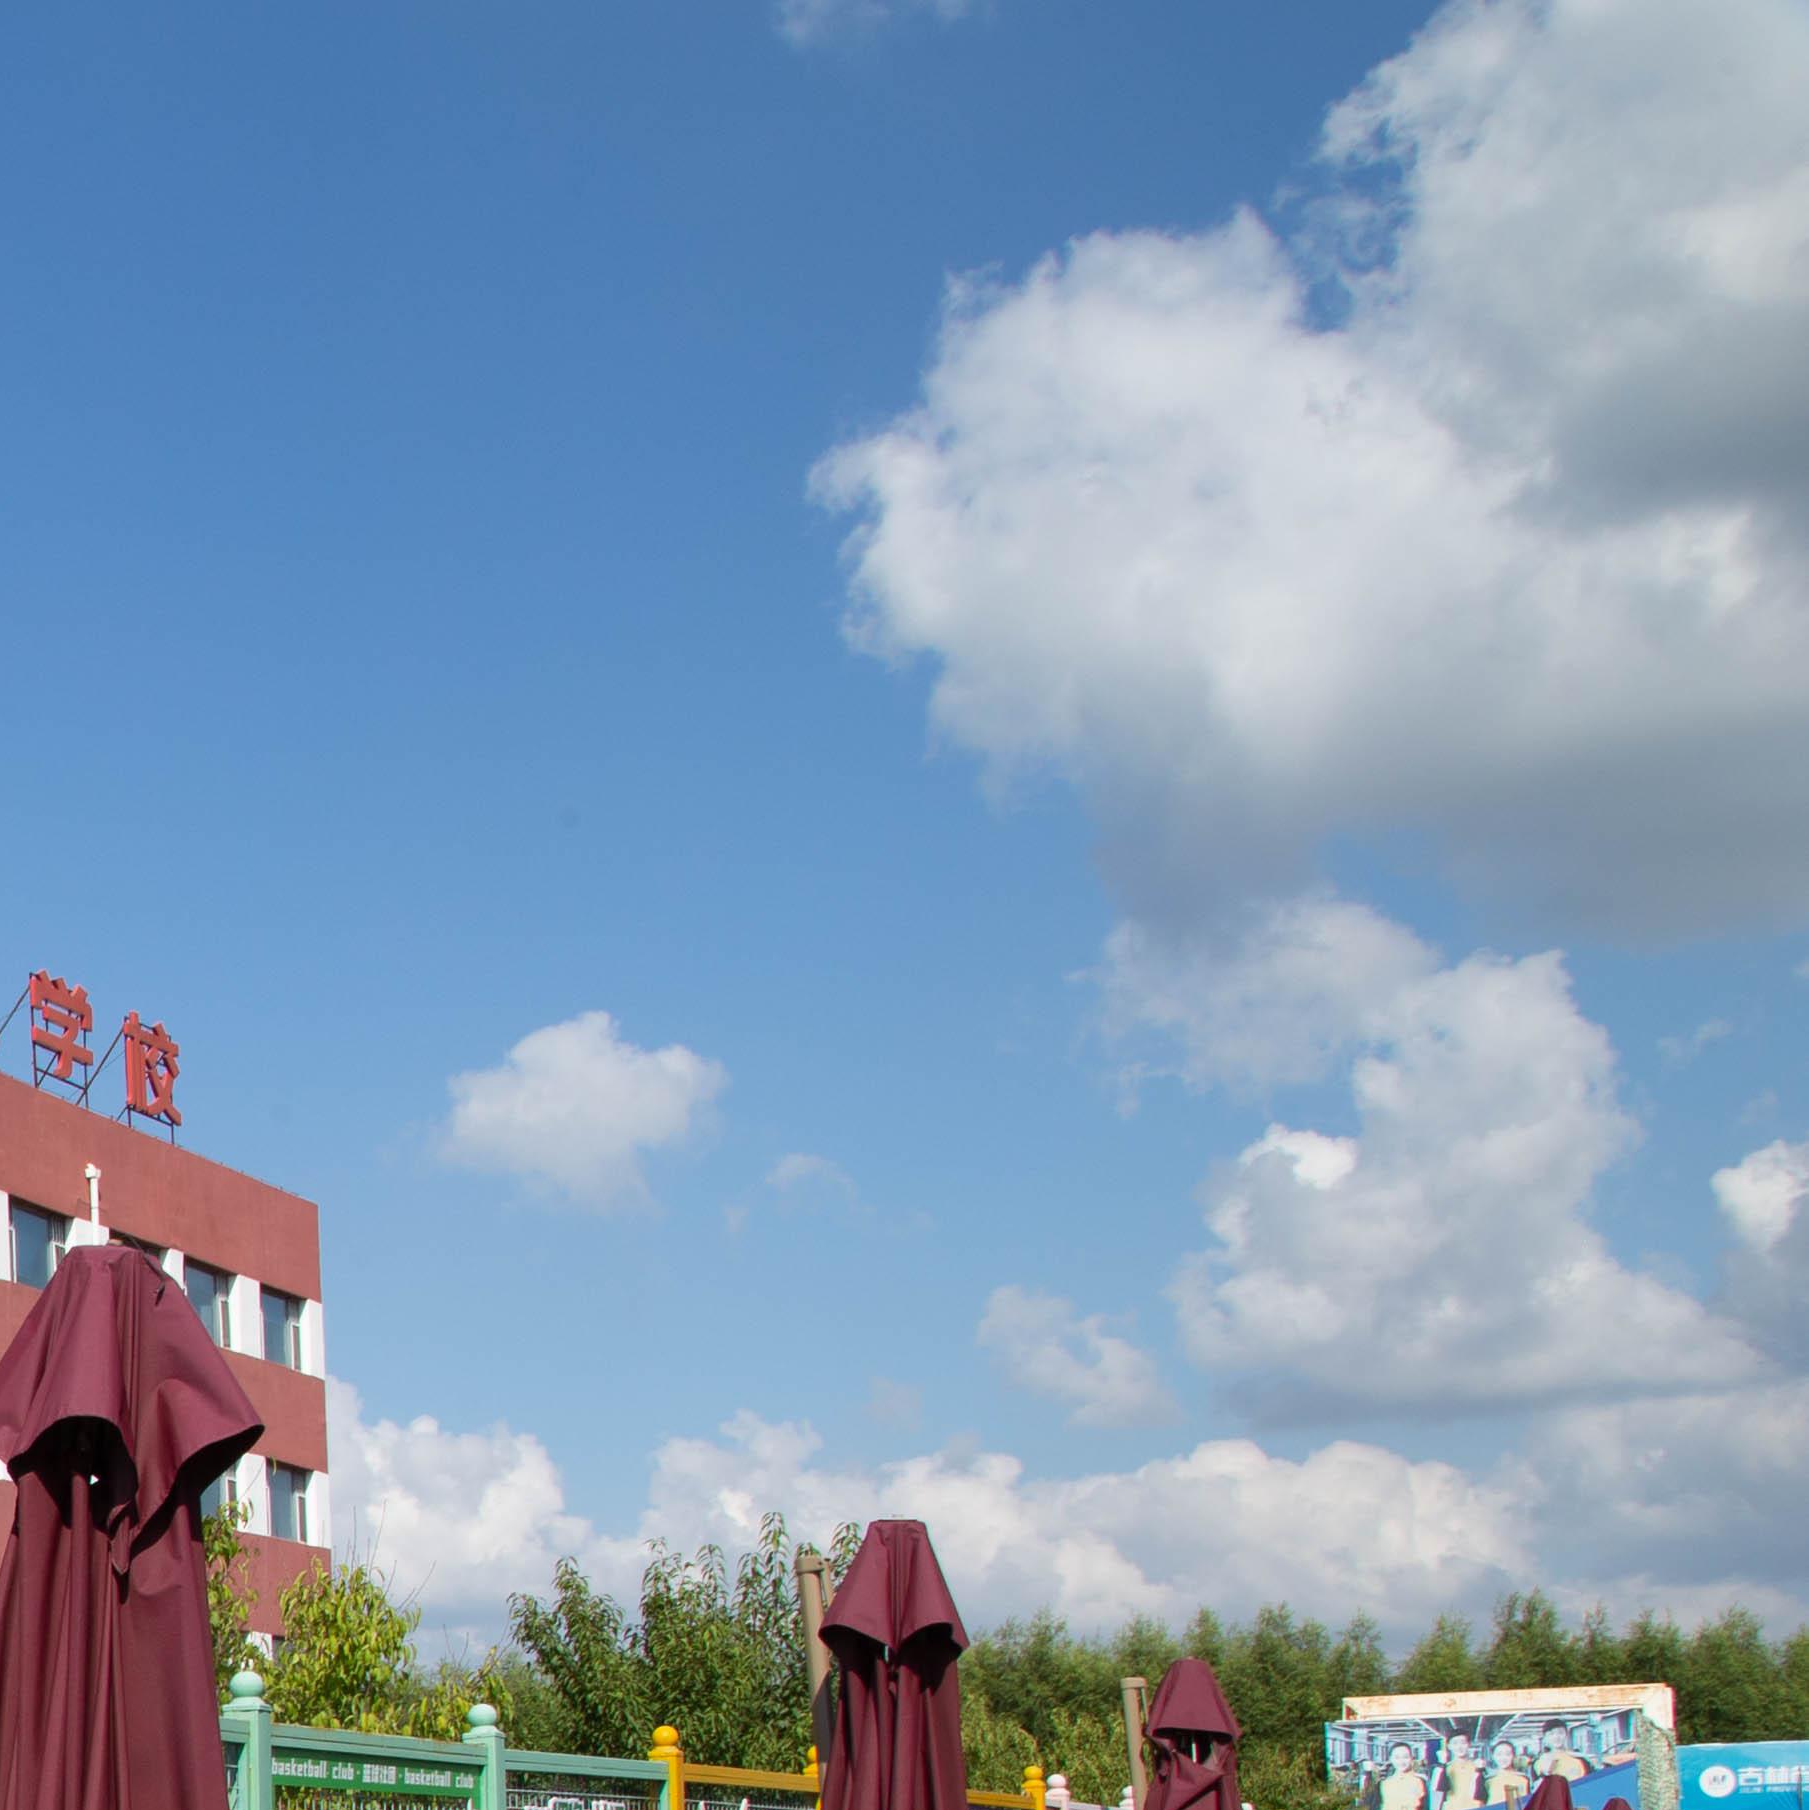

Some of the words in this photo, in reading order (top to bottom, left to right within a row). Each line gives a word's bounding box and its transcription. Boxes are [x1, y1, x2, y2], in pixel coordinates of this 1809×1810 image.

[271, 1757, 327, 1779] basketball
[333, 1762, 355, 1781] club
[404, 1767, 452, 1787] basketball
[456, 1773, 475, 1790] club
